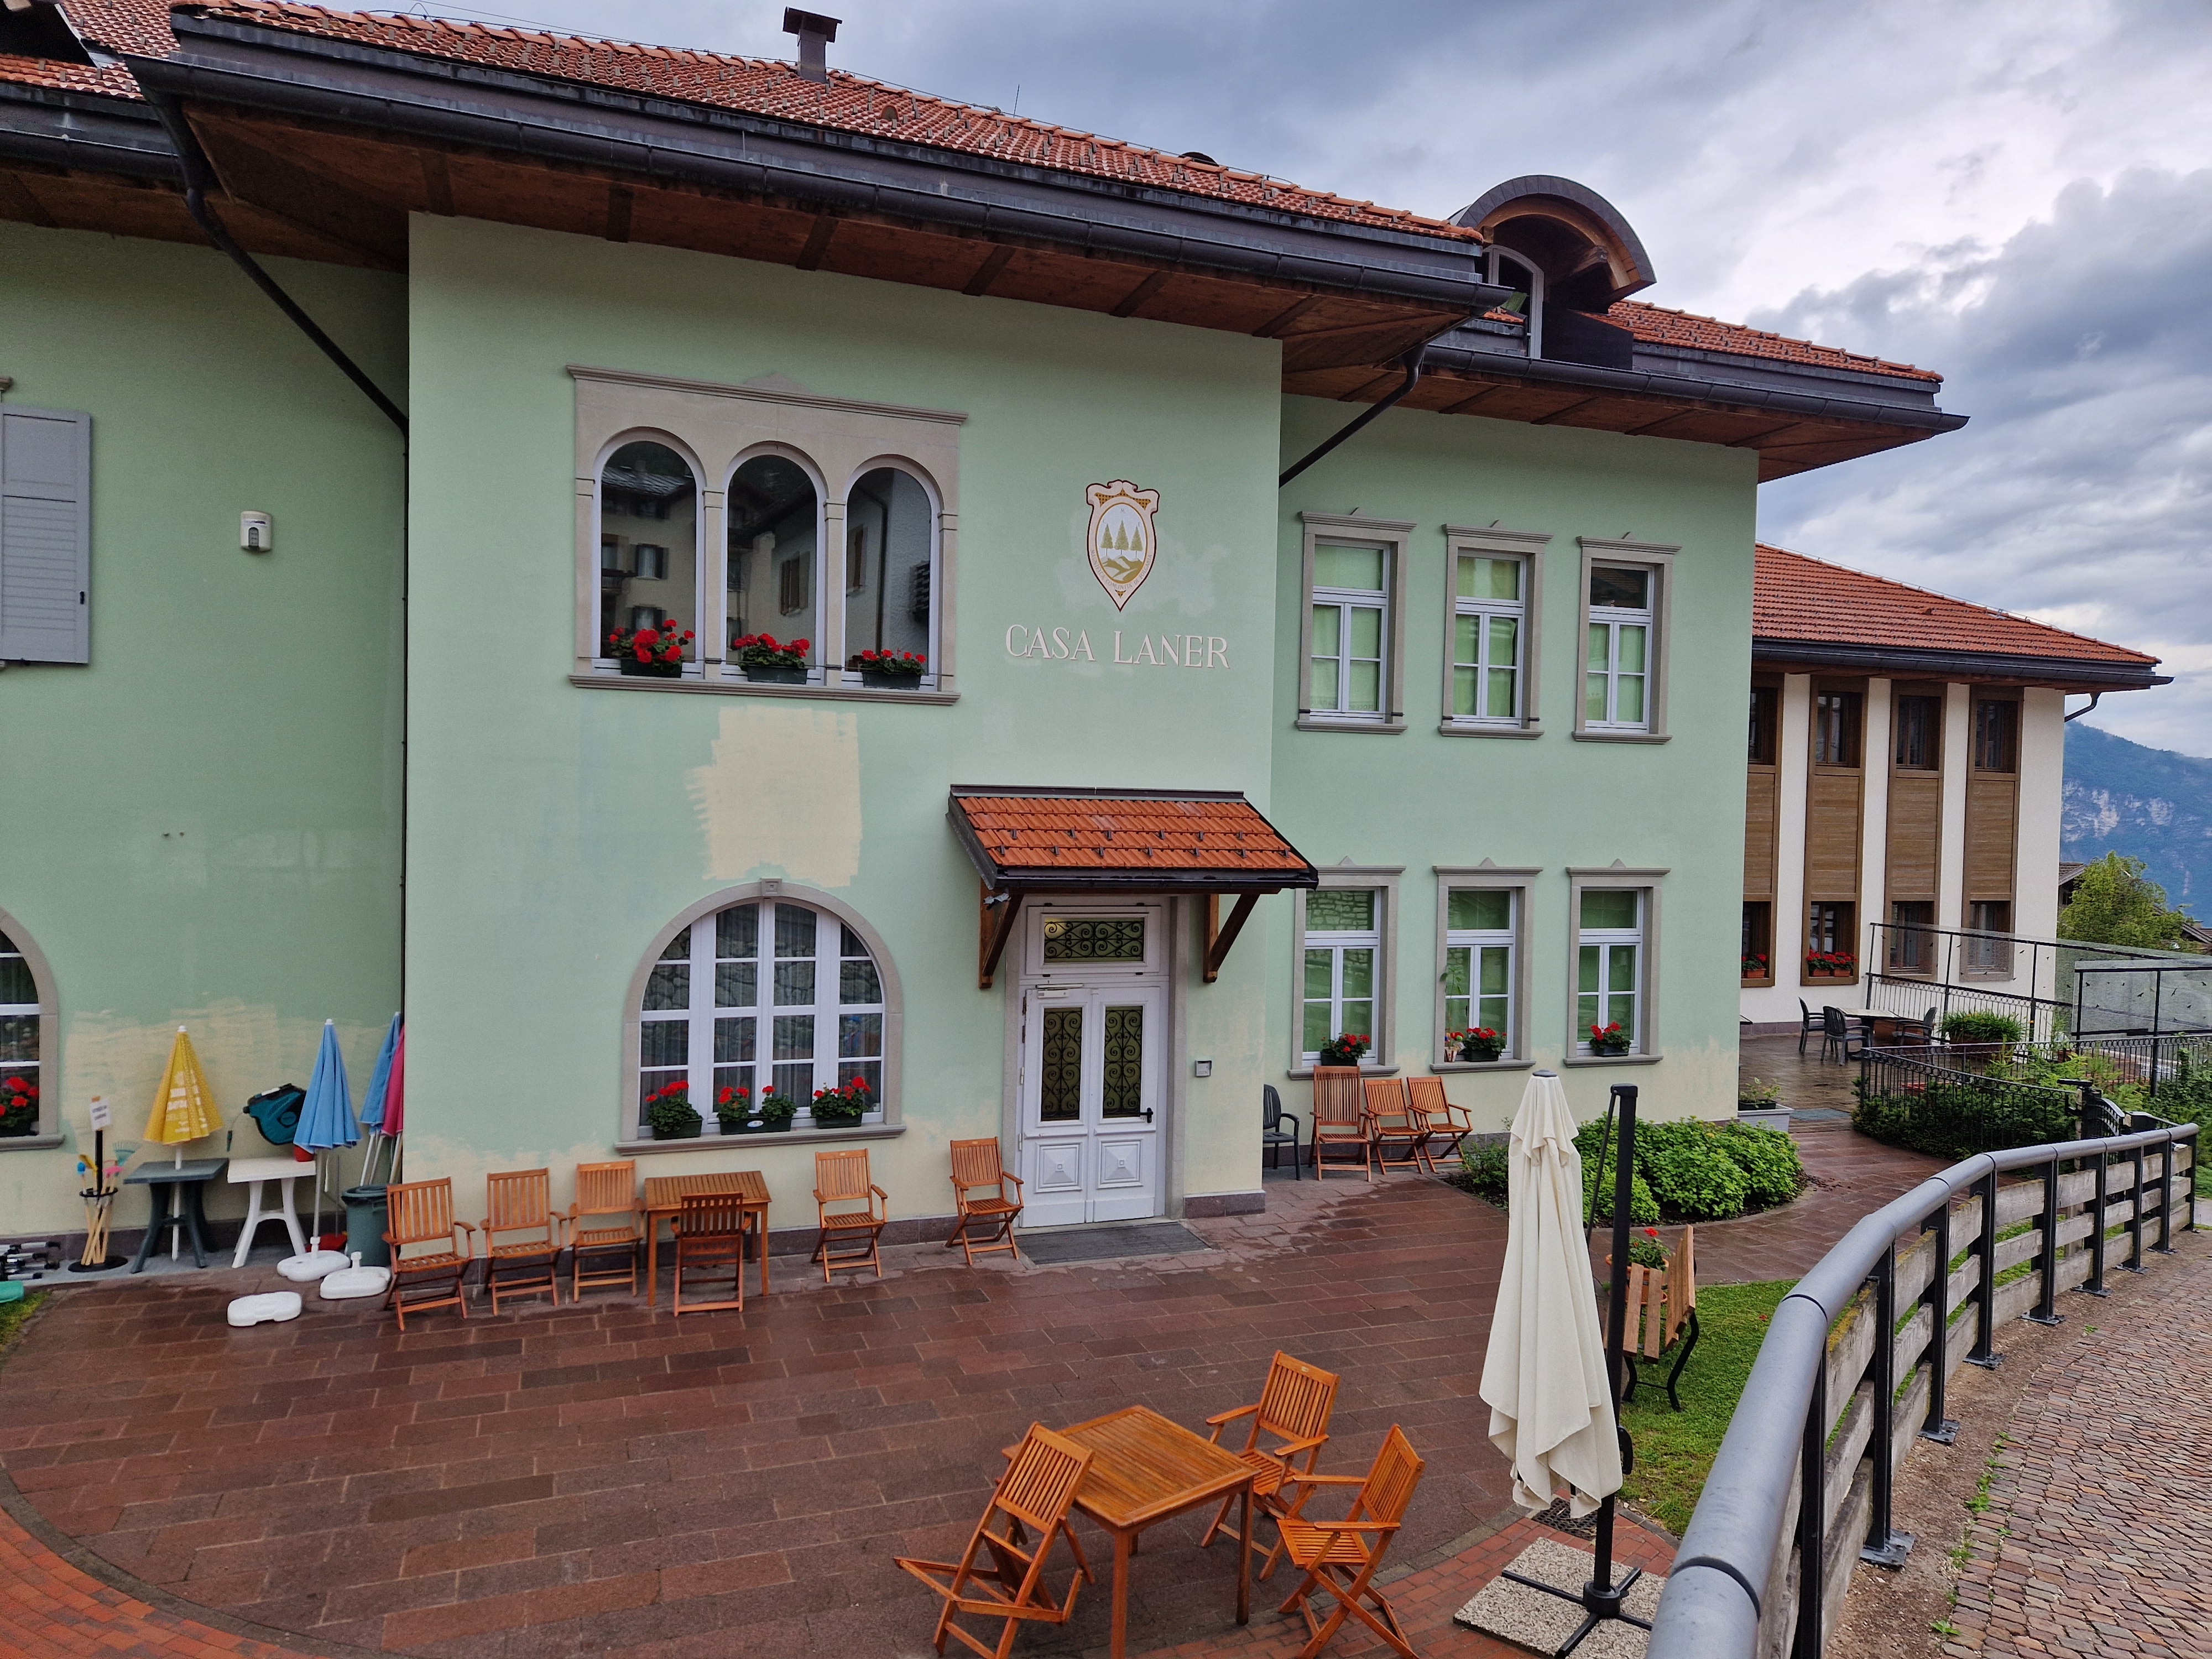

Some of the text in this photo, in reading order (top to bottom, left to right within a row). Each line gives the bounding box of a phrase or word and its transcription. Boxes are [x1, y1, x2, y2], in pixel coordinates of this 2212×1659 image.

[1091, 549, 1105, 580] MAGNIFICA
[1139, 555, 1152, 580] FOLGARIA
[1006, 624, 1230, 669] CASA LANER
